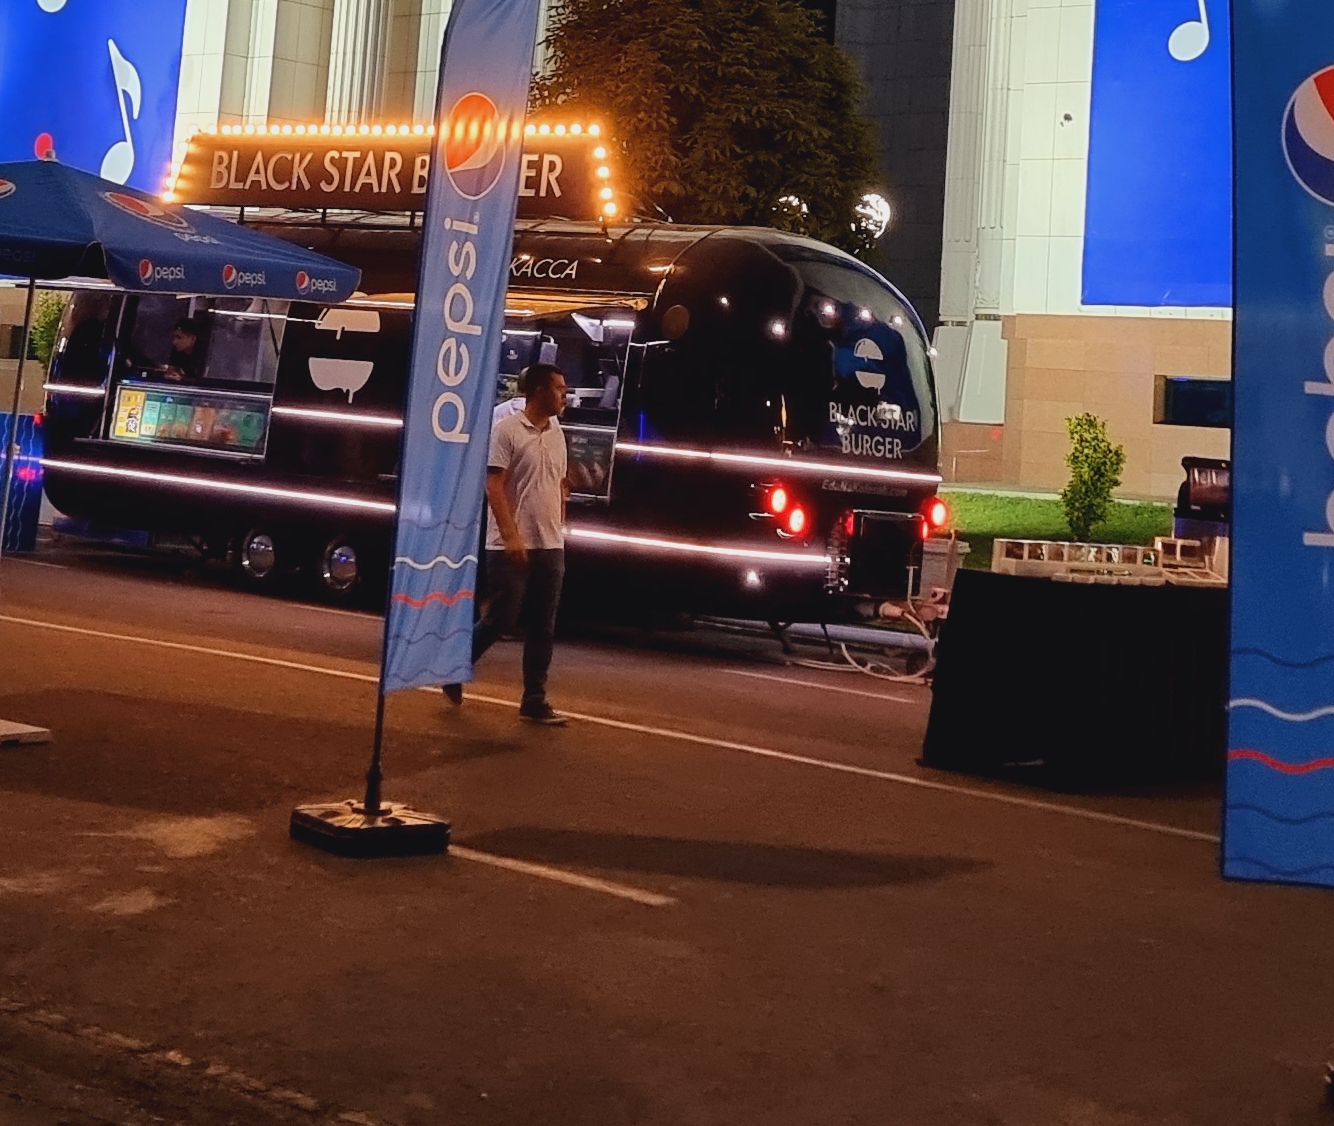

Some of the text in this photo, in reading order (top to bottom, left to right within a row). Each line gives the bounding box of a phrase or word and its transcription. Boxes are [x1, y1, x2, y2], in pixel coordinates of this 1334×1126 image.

[209, 150, 563, 198] BLACK STAR BER
[154, 263, 185, 281] pepsi
[238, 270, 267, 287] pepsi
[310, 277, 338, 294] pepsi
[431, 217, 483, 444] pepsi
[828, 401, 878, 427] BLACK
[841, 433, 903, 459] BURGER
